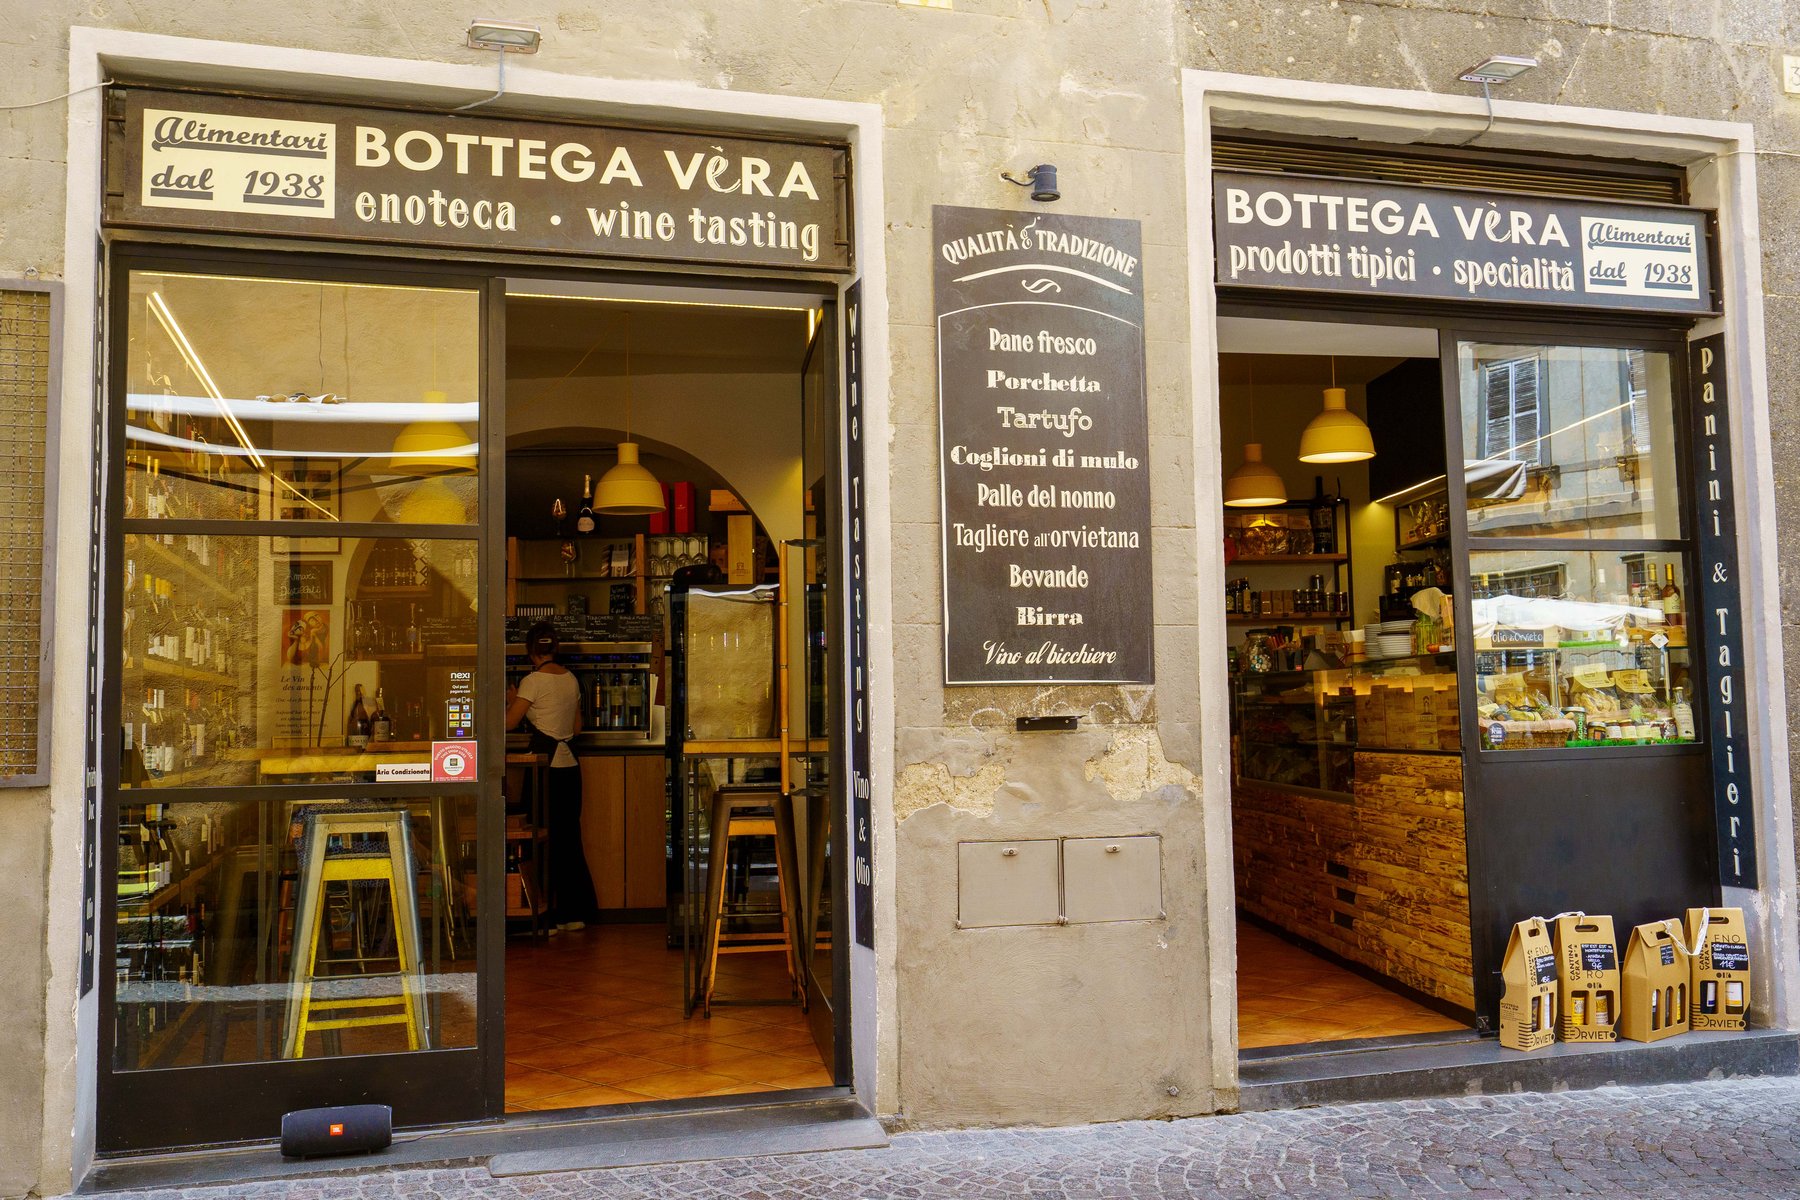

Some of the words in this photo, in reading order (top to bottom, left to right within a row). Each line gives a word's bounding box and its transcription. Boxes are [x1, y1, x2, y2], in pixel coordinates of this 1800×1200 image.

[152, 115, 328, 152] Alimentari
[355, 126, 643, 188] BOTTEGA
[151, 164, 215, 192] dal
[243, 170, 325, 199] 1938
[355, 187, 517, 231] enoteca
[589, 204, 676, 243] wine
[689, 210, 820, 262] tasting
[1226, 188, 1440, 239] BOTTEGA
[1588, 222, 1691, 248] Alimentari
[942, 223, 1019, 265] QUALITÀ
[1035, 229, 1138, 278] TRADIZIONE
[1229, 240, 1341, 279] prodotti
[1348, 246, 1416, 285] tipici
[1454, 256, 1576, 293] specialità
[1589, 259, 1627, 281] dal
[1644, 262, 1691, 286] 1938
[989, 328, 1034, 353] Pane
[1037, 330, 1097, 356] fresco
[848, 303, 859, 441] Wine
[986, 369, 1101, 393] Porchetta
[996, 406, 1093, 438] Tartufo
[1700, 347, 1721, 537] Panini
[950, 445, 1047, 472] Coglioni
[1052, 448, 1075, 468] di
[1080, 451, 1139, 470] mulo
[977, 483, 1023, 507] Palle
[1028, 484, 1056, 508] del
[1060, 490, 1116, 510] nonno
[953, 523, 1029, 553] Tagliere
[1009, 564, 1089, 588] Bevande
[1712, 562, 1728, 583] &
[852, 476, 864, 733] Tasting
[1015, 606, 1084, 626] Birra
[983, 640, 1023, 665] Vino
[1025, 640, 1051, 665] al
[1046, 643, 1117, 665] bicchiere
[1716, 607, 1741, 877] Taglieri
[853, 770, 870, 800] Vino
[858, 817, 867, 843] &
[856, 855, 871, 887] Olio
[1535, 945, 1550, 956] ENO
[1714, 934, 1741, 944] ENO
[1567, 944, 1576, 981] CANTINA
